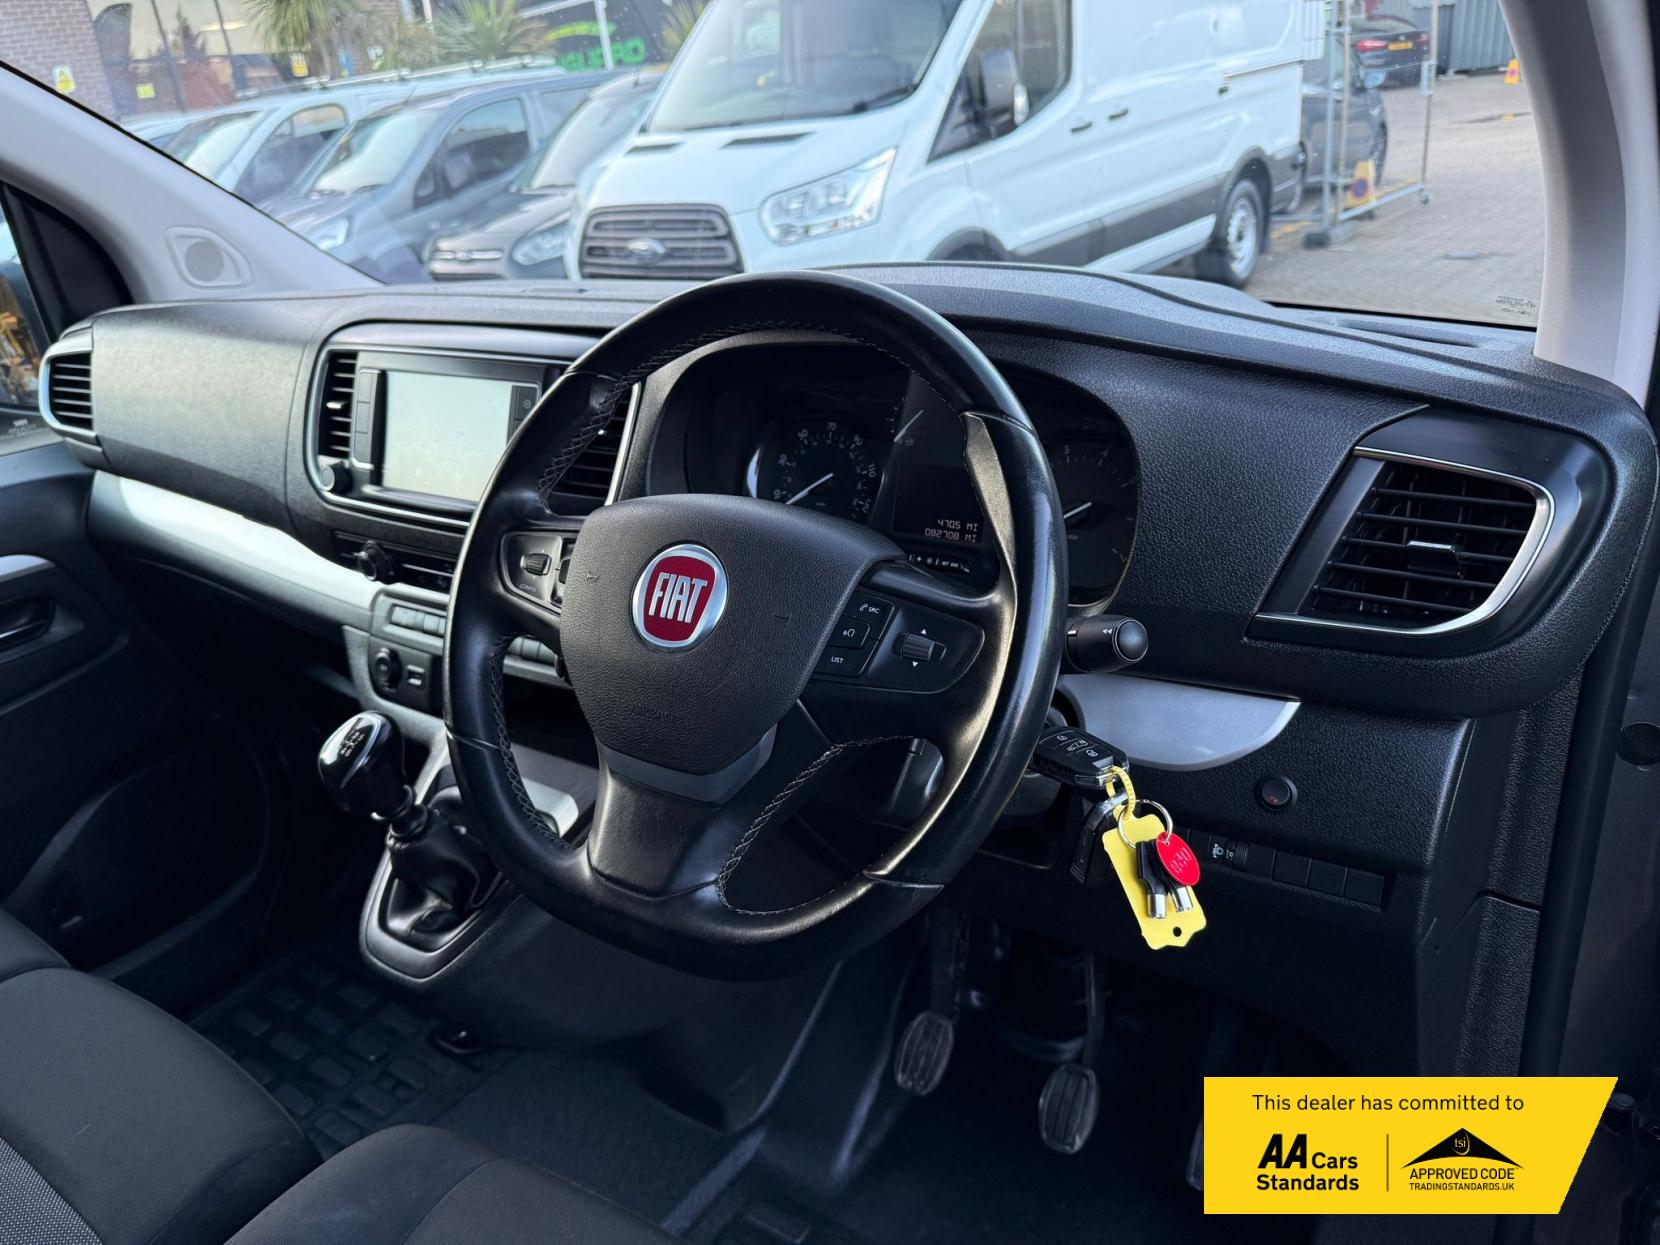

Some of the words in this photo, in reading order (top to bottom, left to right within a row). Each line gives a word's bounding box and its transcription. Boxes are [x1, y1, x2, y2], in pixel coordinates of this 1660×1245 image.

[828, 422, 837, 431] 70
[966, 523, 978, 532] MI
[924, 528, 960, 540] 082708
[964, 534, 977, 543] MI
[648, 572, 708, 624] FIAT
[868, 605, 880, 614] SRC
[831, 656, 844, 664] LIST
